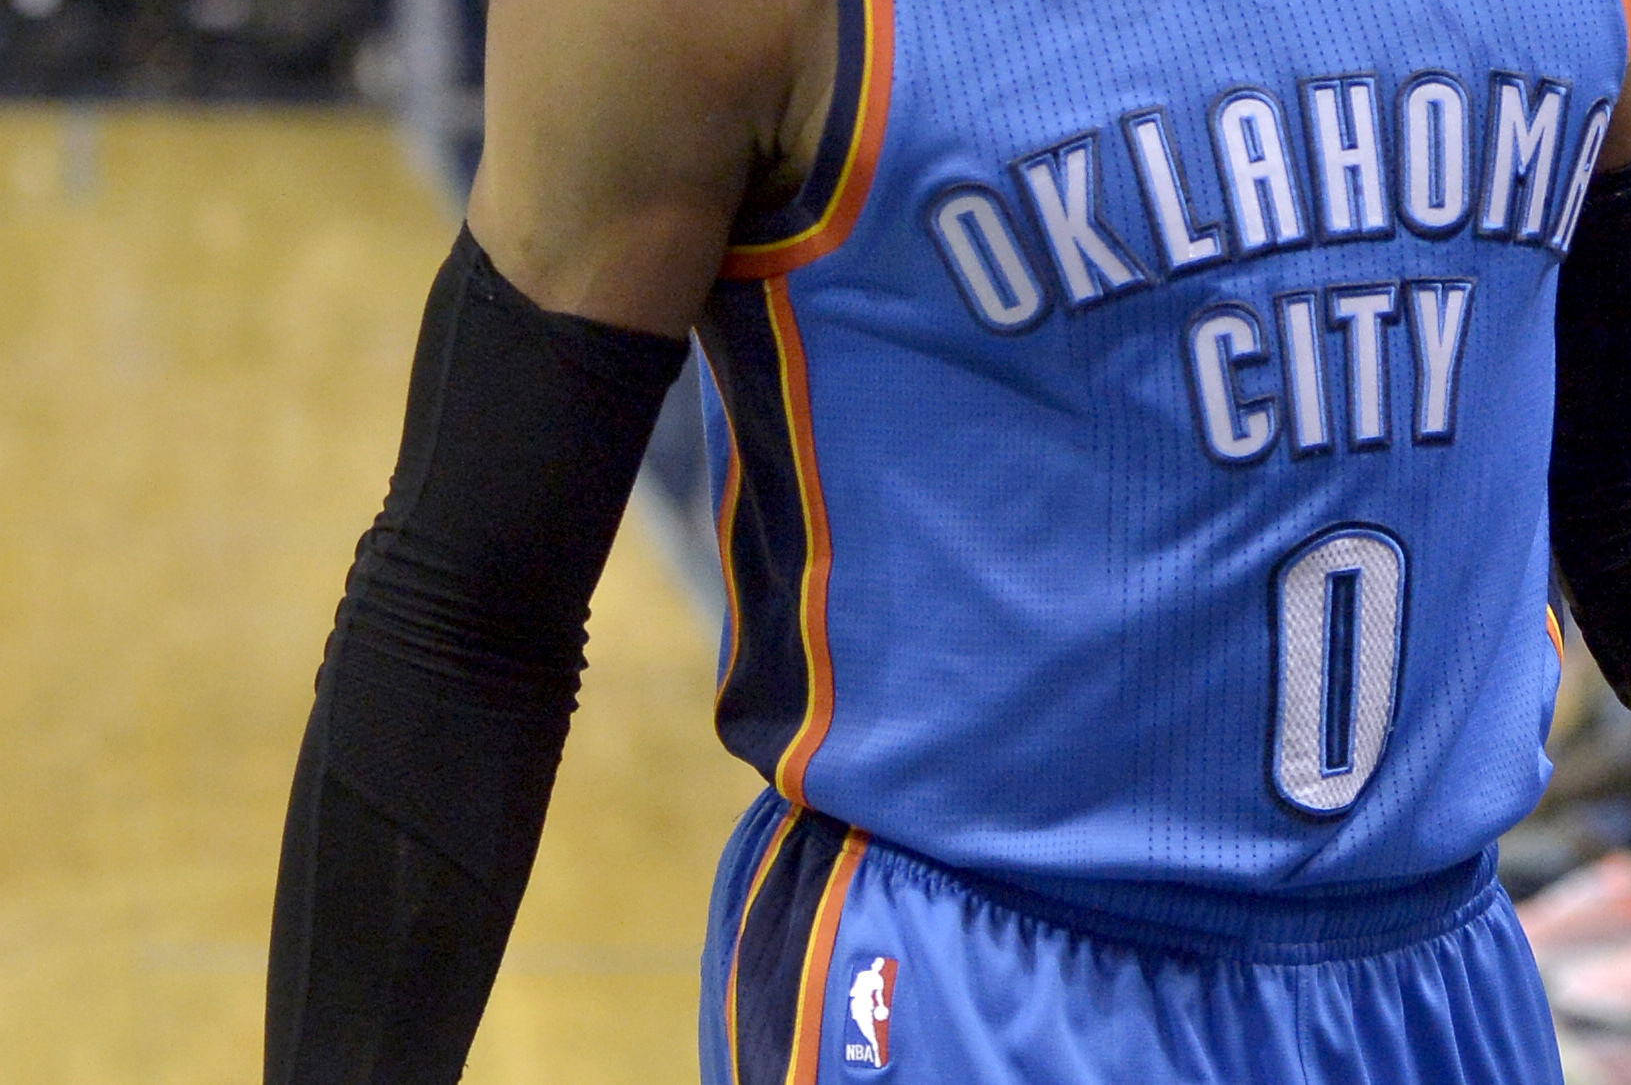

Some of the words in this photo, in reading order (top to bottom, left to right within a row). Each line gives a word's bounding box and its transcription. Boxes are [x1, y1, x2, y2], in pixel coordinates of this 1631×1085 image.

[926, 70, 1614, 333] OKLAHOMA
[1187, 278, 1477, 465] CITY
[1267, 521, 1412, 818] 0
[845, 1044, 874, 1063] NBA
